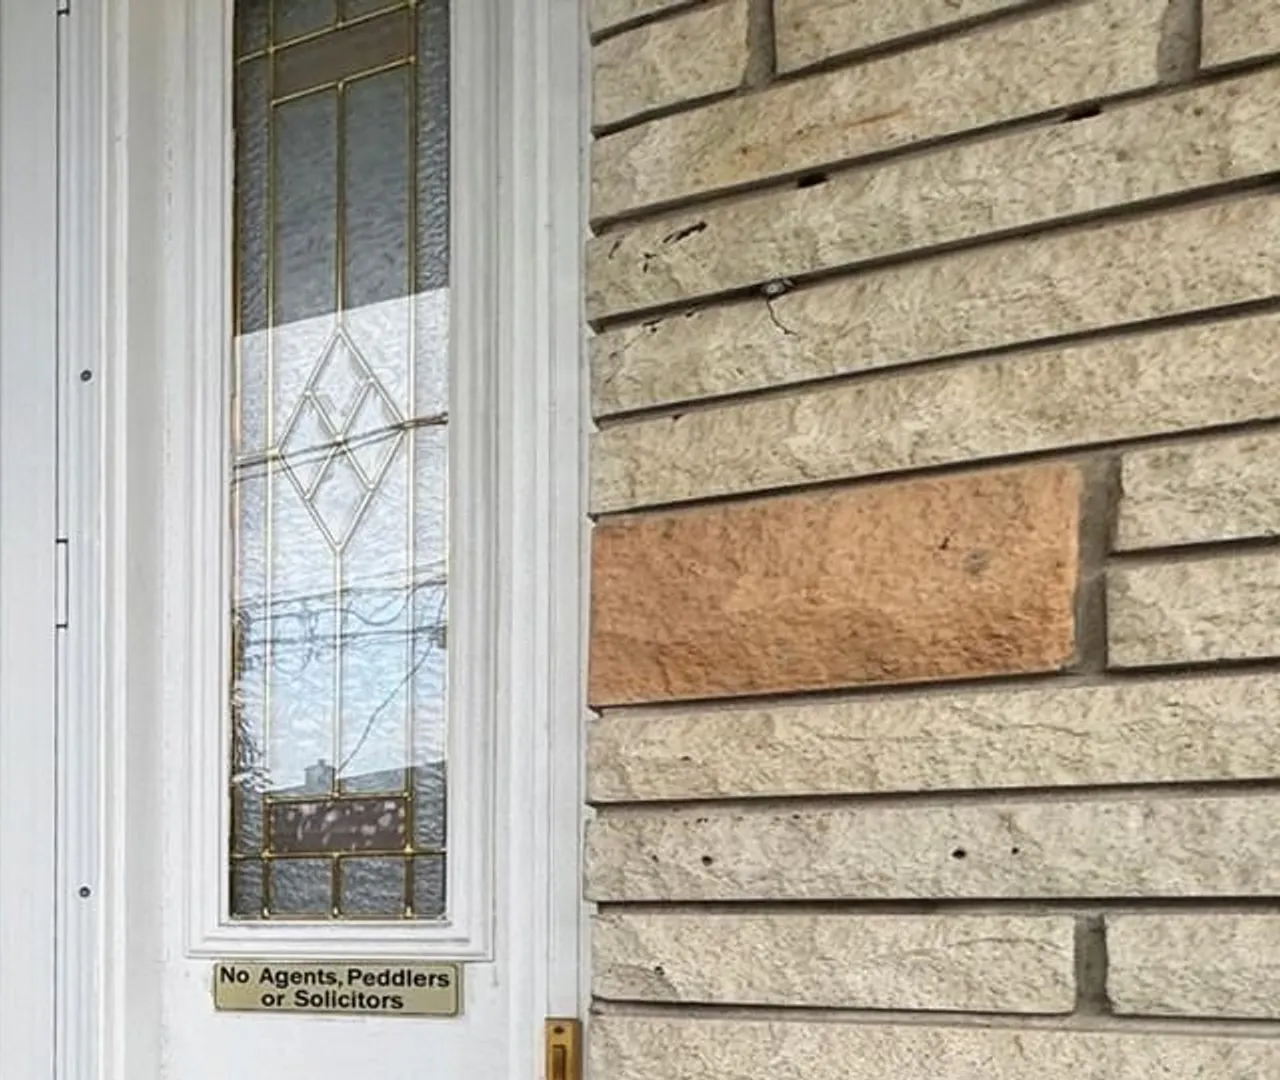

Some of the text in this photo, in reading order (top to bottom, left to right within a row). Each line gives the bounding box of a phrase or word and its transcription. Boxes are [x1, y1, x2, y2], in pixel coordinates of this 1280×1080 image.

[220, 966, 450, 988] No Agents, Peddlers
[261, 990, 404, 1009] or Solicitors
